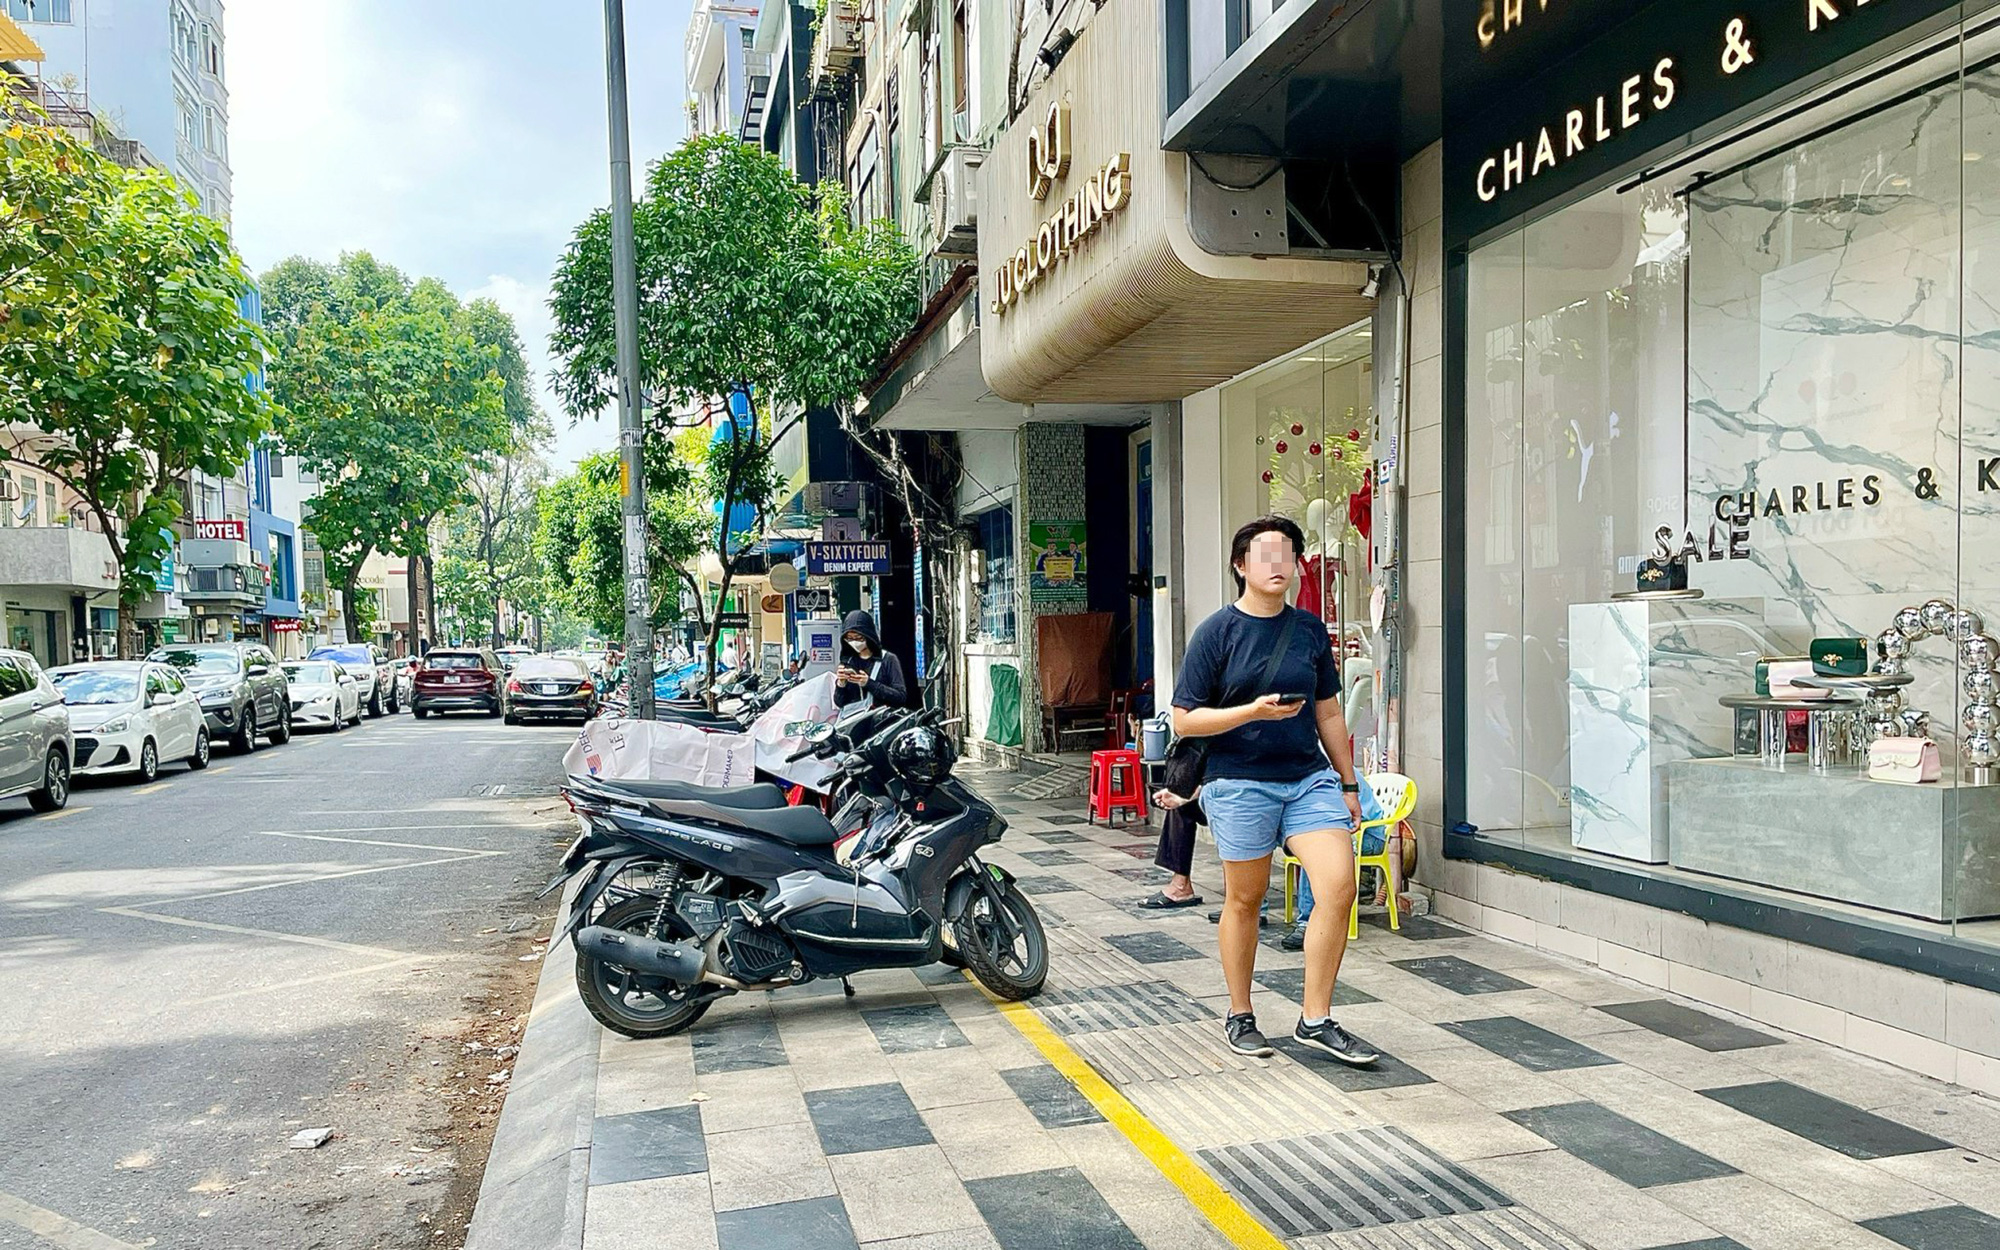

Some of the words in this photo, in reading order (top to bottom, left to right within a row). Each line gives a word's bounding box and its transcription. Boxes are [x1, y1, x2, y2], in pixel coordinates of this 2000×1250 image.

[1476, 57, 1674, 202] CHARLES
[1721, 17, 1753, 74] &
[1715, 475, 1880, 522] CHARLES
[1914, 467, 1939, 499] &
[196, 522, 242, 539] HOTEL
[1651, 513, 1751, 567] SALE
[810, 544, 887, 561] V-SIXTYFOUR
[823, 562, 846, 573] DENIM
[847, 561, 874, 572] EXPERT
